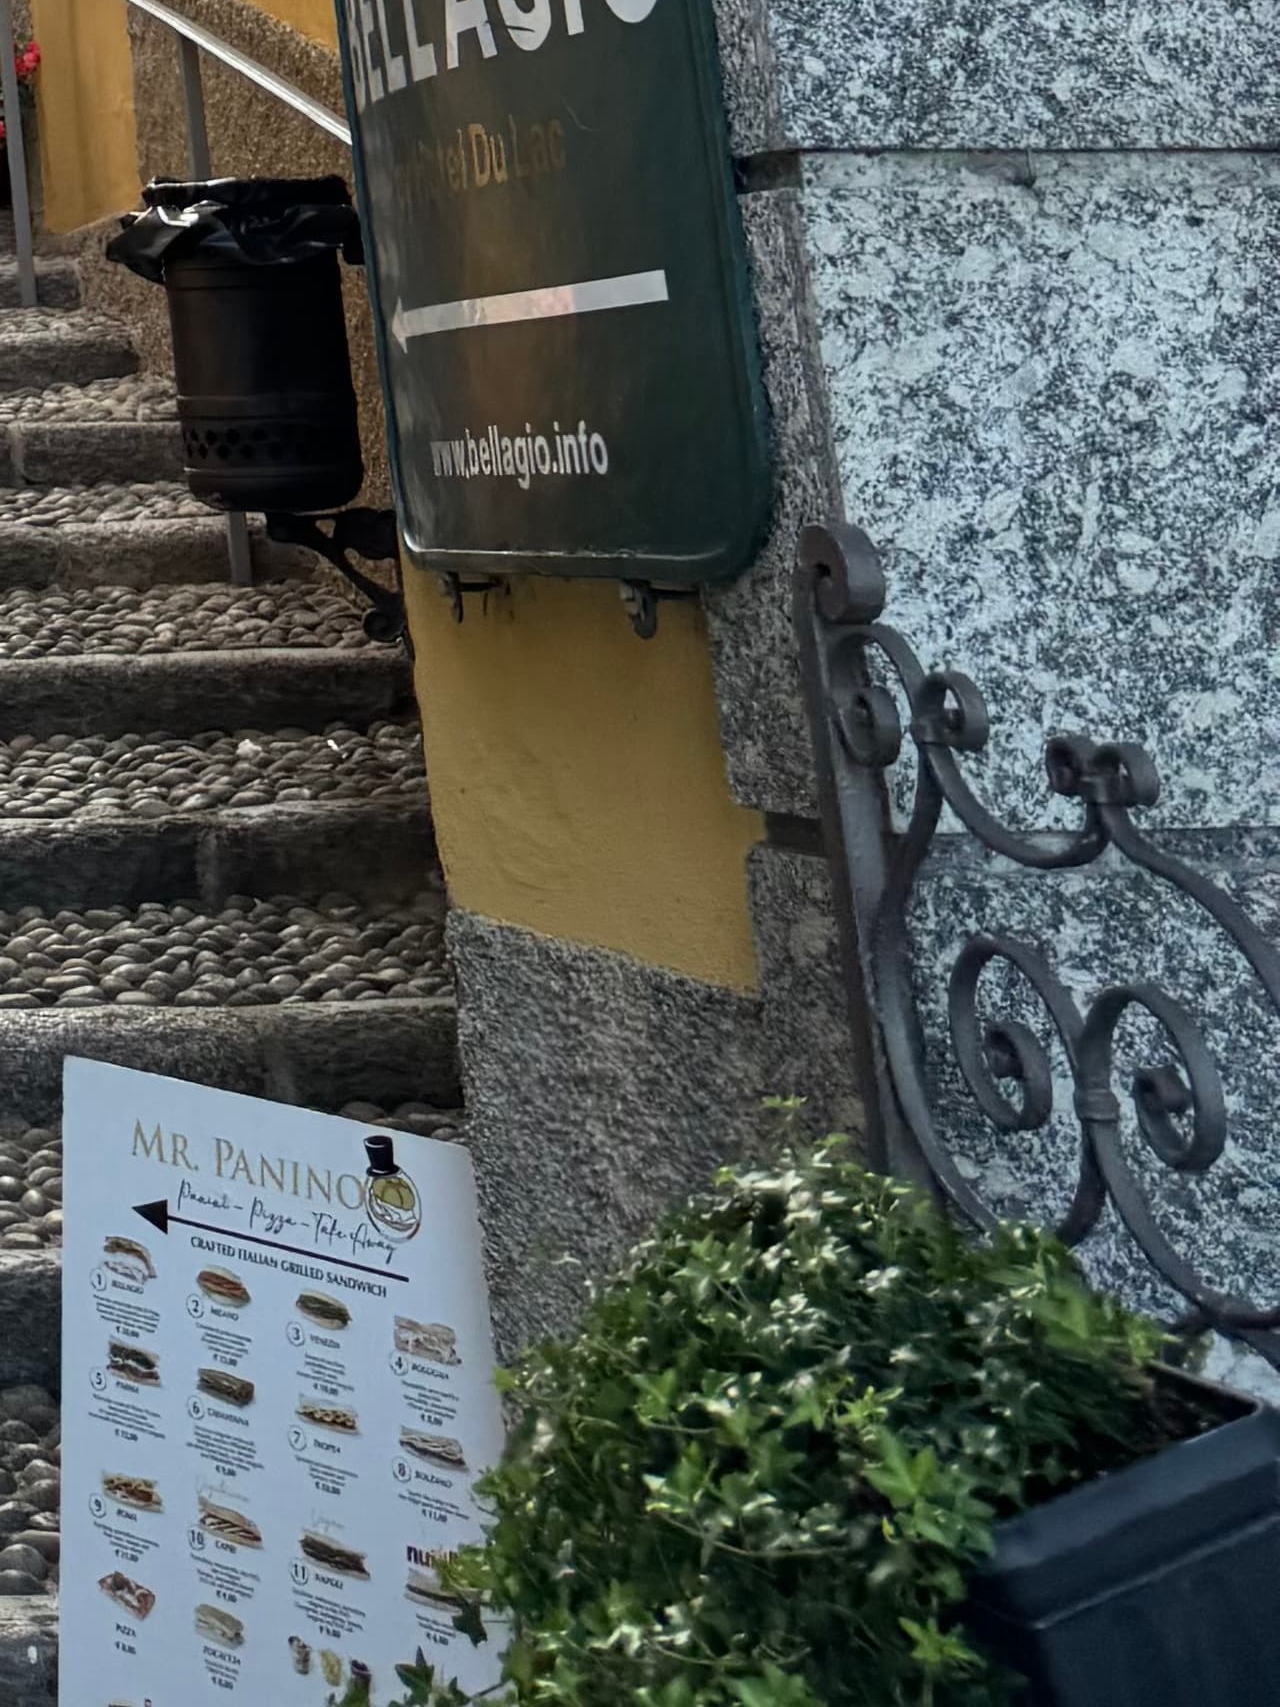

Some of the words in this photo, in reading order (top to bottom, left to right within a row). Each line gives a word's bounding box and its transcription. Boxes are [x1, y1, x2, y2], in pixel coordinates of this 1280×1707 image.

[468, 122, 509, 188] Du
[131, 1117, 198, 1172] MR.
[213, 1136, 366, 1210] PANINO
